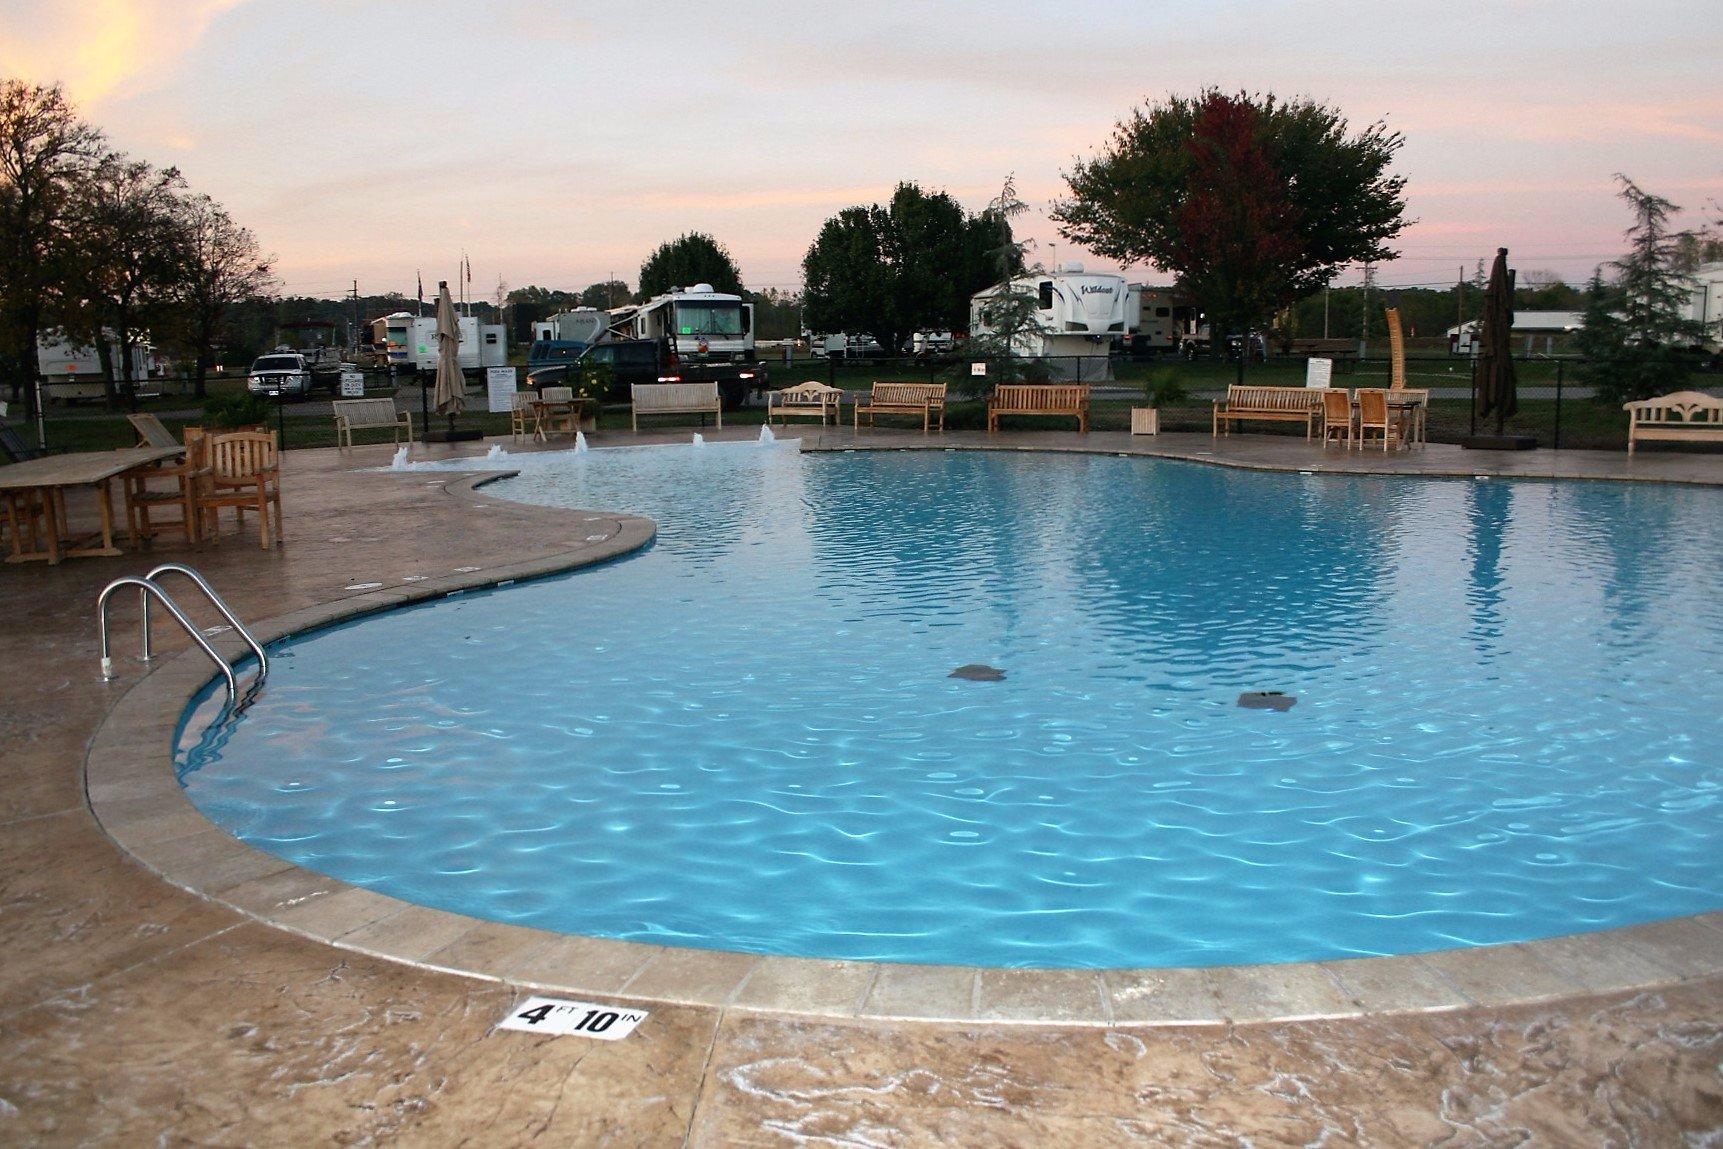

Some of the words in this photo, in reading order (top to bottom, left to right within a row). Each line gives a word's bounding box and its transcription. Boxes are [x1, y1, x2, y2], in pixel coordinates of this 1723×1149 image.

[518, 1004, 556, 1025] 4
[556, 1005, 579, 1015] FT
[574, 1009, 620, 1033] 10
[621, 1013, 642, 1023] IN
